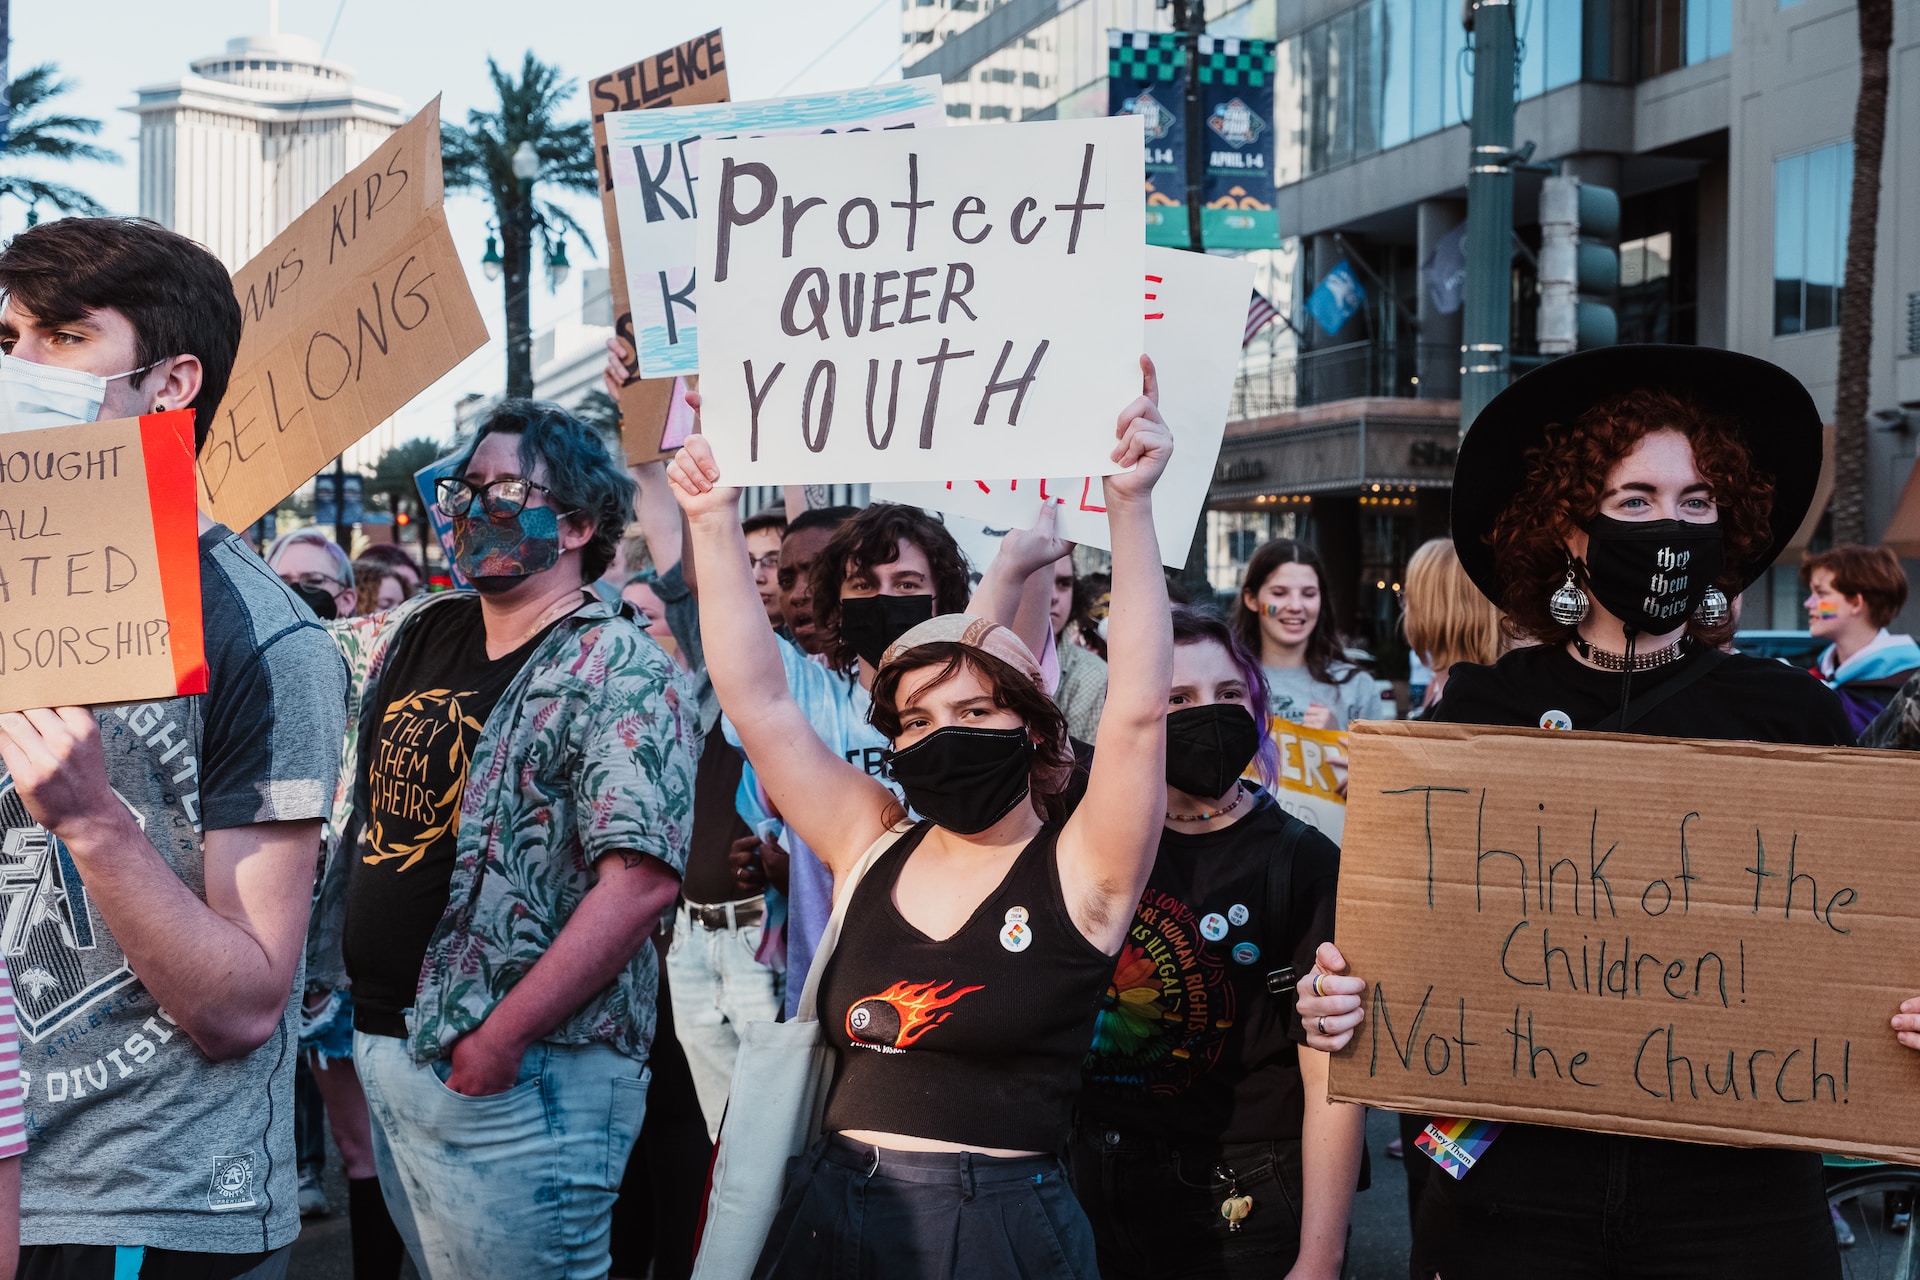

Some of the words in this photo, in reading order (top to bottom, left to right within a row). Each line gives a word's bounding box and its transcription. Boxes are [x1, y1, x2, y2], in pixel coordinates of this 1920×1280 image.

[594, 29, 726, 112] SILENCE
[329, 147, 409, 265] KIDS
[715, 143, 1105, 282] Protect
[780, 262, 978, 341] QUEER
[196, 255, 436, 504] BELONG
[743, 337, 1050, 463] YOUTH
[1650, 573, 1689, 597] them
[1656, 546, 1690, 572] they
[1642, 594, 1690, 619] theirs
[379, 738, 430, 784] THEM
[390, 711, 449, 748] THEY
[374, 770, 437, 826] THEIRS
[1380, 786, 1620, 920] Think
[1641, 811, 1700, 917] of
[1745, 828, 1859, 935] the
[1131, 925, 1151, 942] IS
[1501, 921, 1746, 1009] Children!
[1158, 917, 1198, 971] HUMAN
[1184, 972, 1209, 1034] RIGHTS
[1370, 981, 1481, 1086] Not
[1504, 1004, 1601, 1087] the
[1634, 1023, 1851, 1105] Church!
